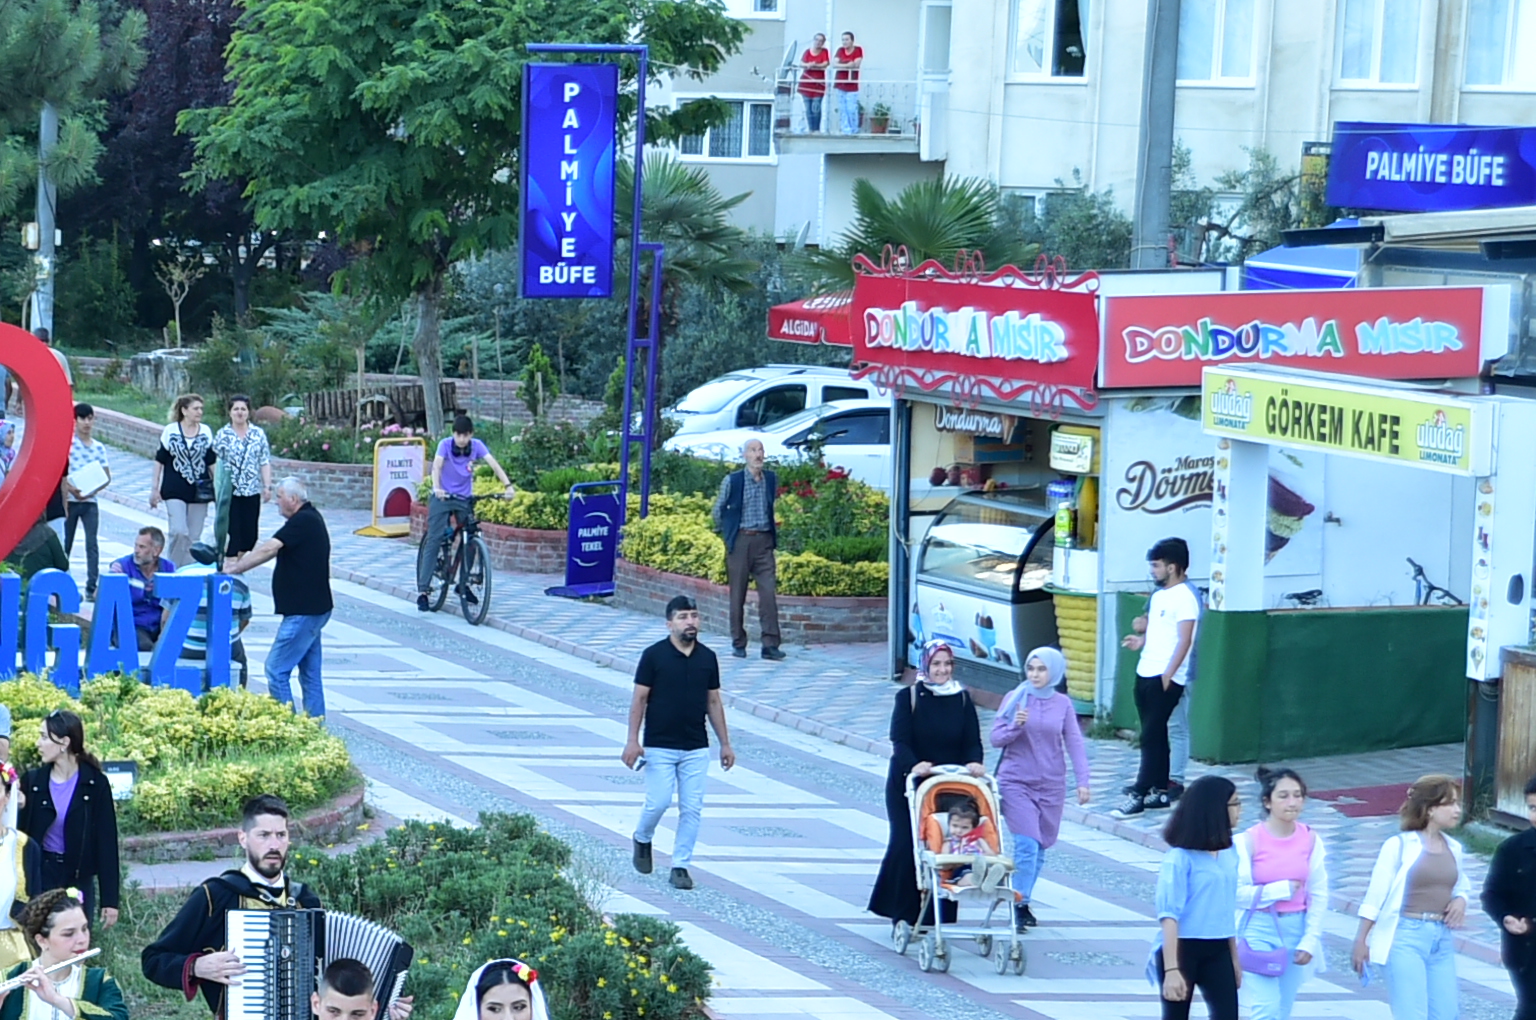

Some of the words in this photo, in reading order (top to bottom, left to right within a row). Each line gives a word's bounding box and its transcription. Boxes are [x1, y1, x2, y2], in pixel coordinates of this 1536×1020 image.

[560, 82, 581, 258] PALMİYE
[1365, 144, 1448, 184] PALMİYE
[1451, 148, 1505, 187] BÜFE
[539, 262, 597, 284] BÜFE
[990, 312, 1069, 363] MISIR
[1122, 317, 1344, 363] DONDURMA
[1355, 316, 1463, 355] MISIR
[1265, 388, 1344, 447] GÖRKEM
[1351, 408, 1400, 455] KAFE
